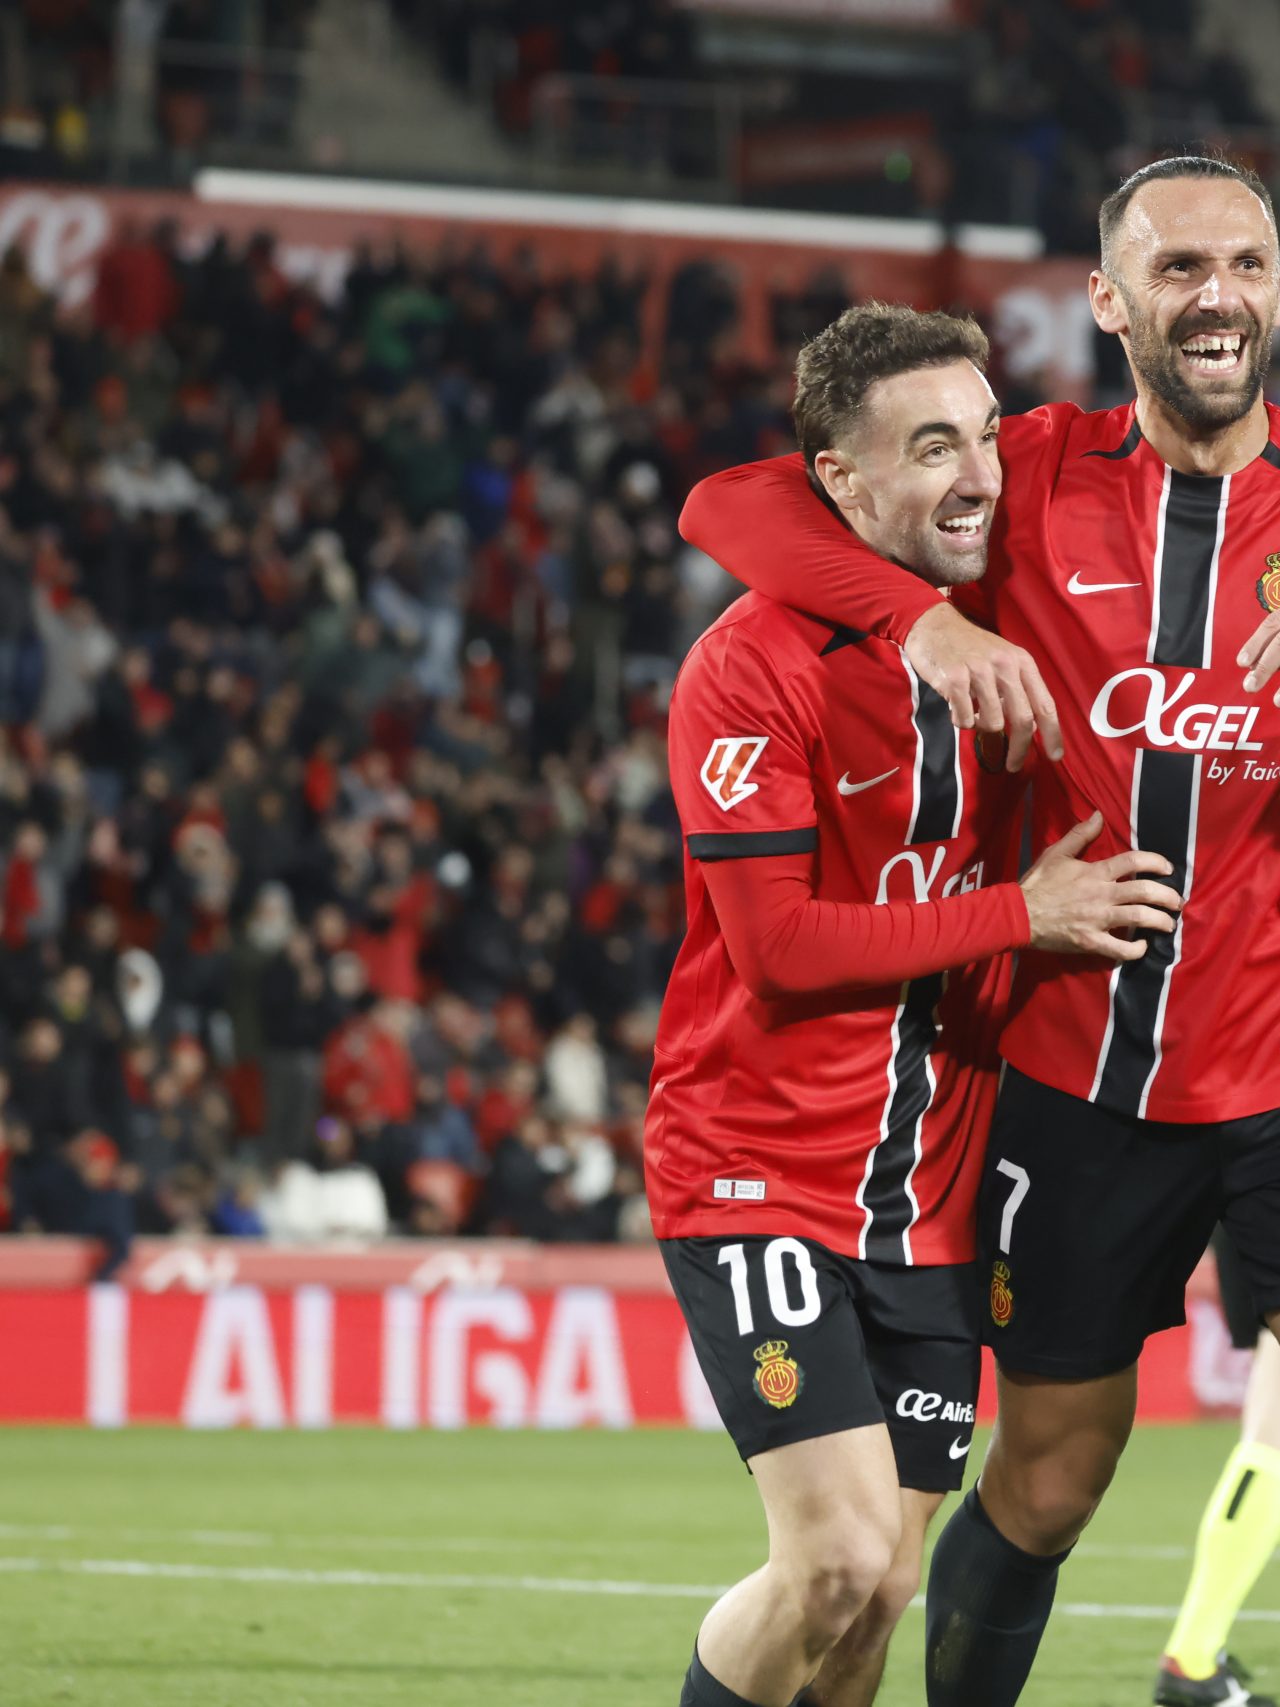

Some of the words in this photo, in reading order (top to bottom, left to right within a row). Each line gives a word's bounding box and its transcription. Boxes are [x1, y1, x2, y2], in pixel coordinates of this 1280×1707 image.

[1206, 757, 1236, 785] by
[996, 1158, 1031, 1255] 7
[717, 1237, 821, 1336] 10
[940, 1401, 975, 1423] AirE
